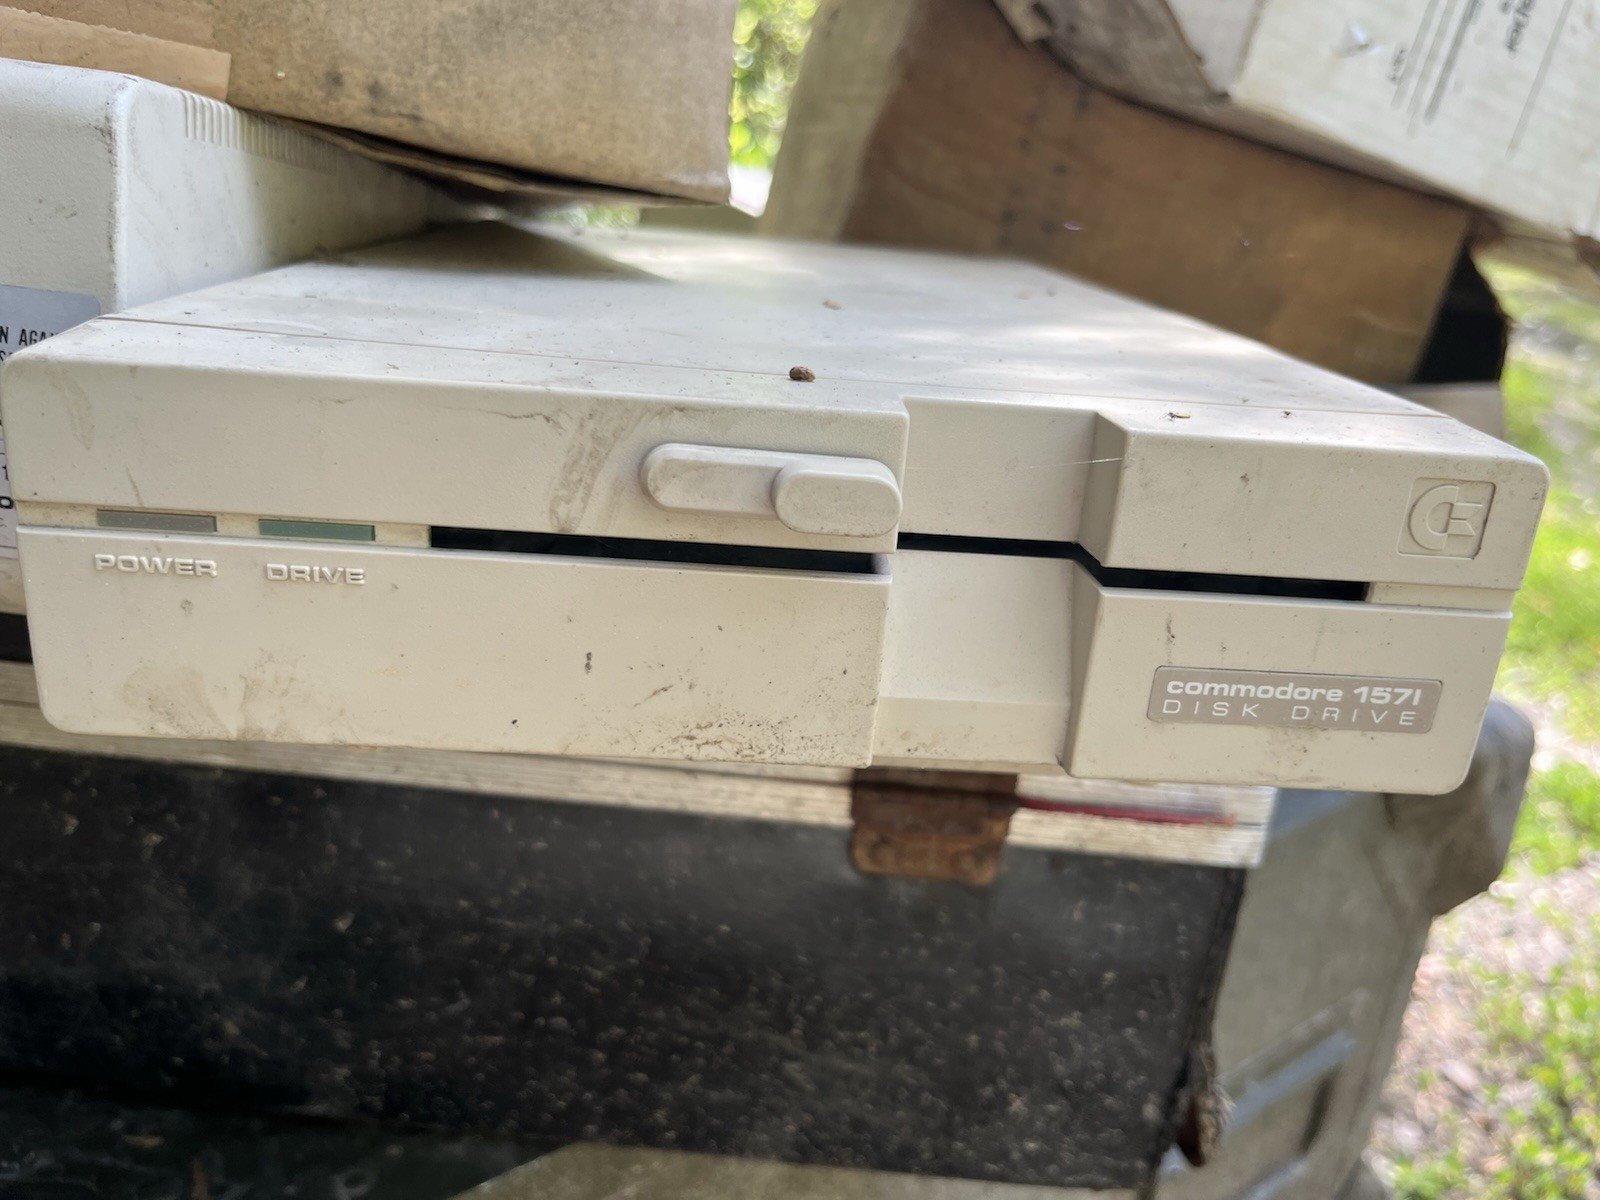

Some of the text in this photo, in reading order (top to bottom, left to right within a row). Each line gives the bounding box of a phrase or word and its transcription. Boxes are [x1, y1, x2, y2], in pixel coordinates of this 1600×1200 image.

[94, 553, 218, 578] POWER
[266, 562, 366, 585] DRIVE
[1166, 680, 1422, 706] commodore 1571
[1162, 700, 1416, 726] DISK DRIVE
